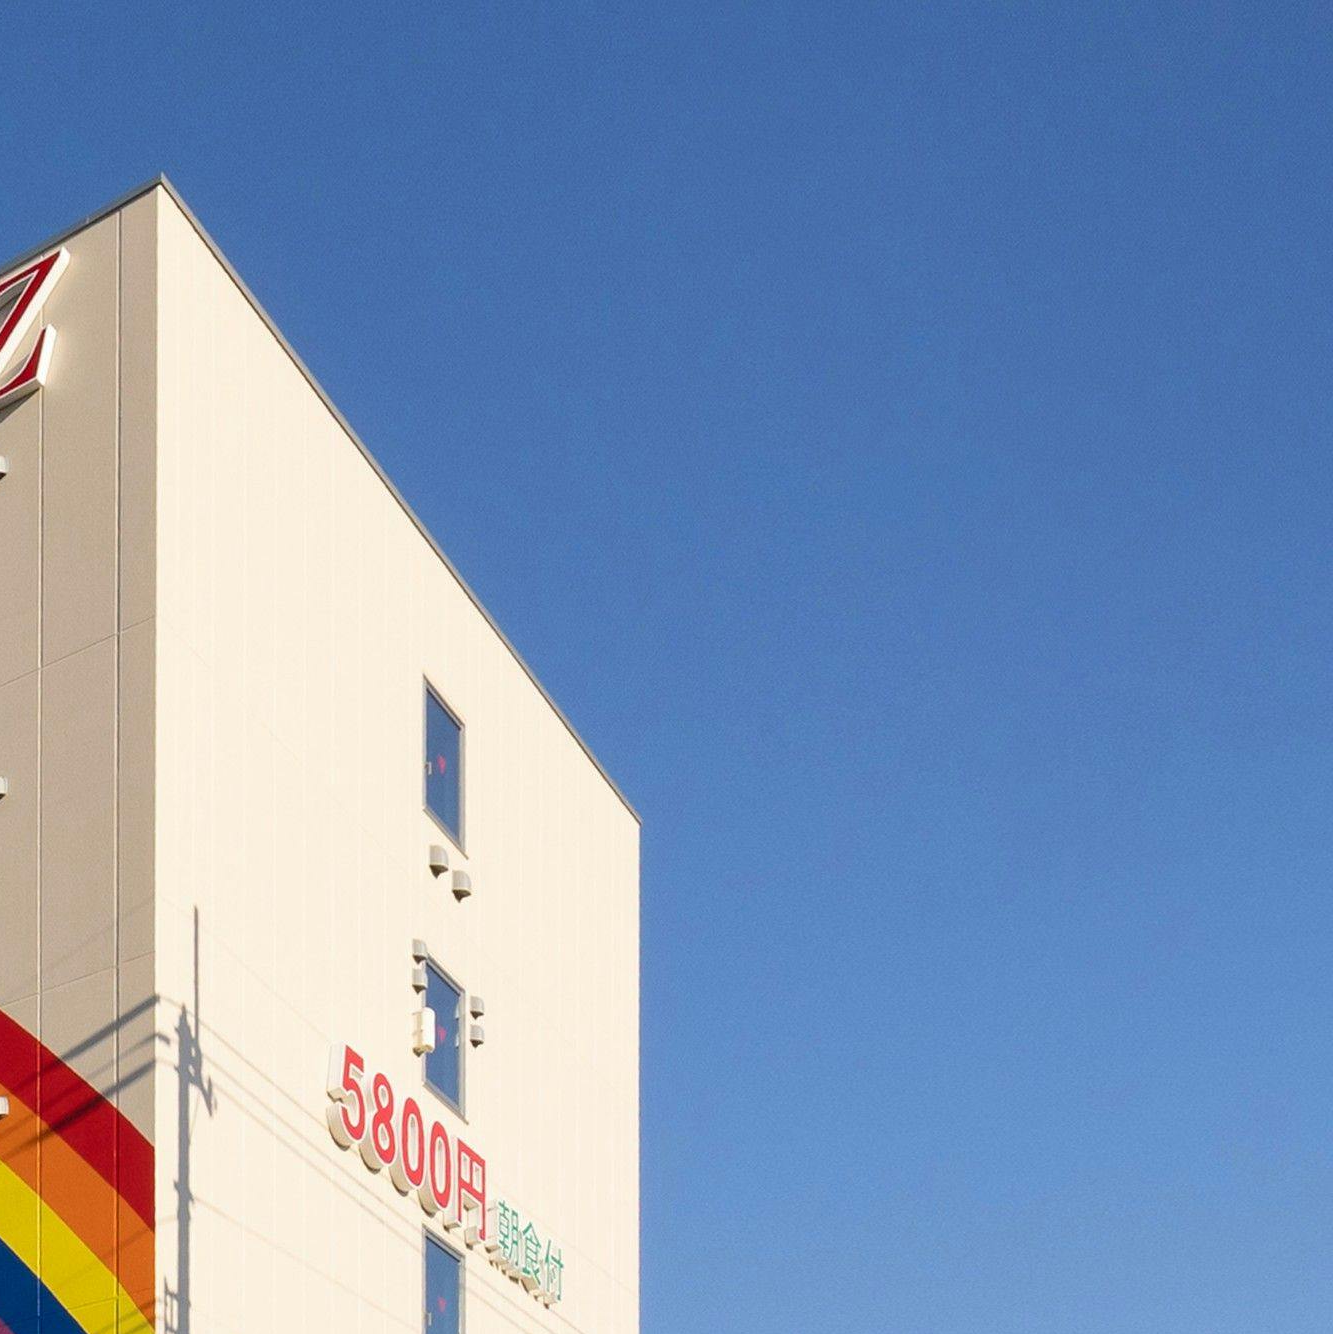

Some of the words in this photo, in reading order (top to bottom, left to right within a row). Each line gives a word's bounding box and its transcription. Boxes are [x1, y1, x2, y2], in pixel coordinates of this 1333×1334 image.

[333, 1042, 487, 1243] 5800円
[493, 1199, 566, 1301] 朝食付
